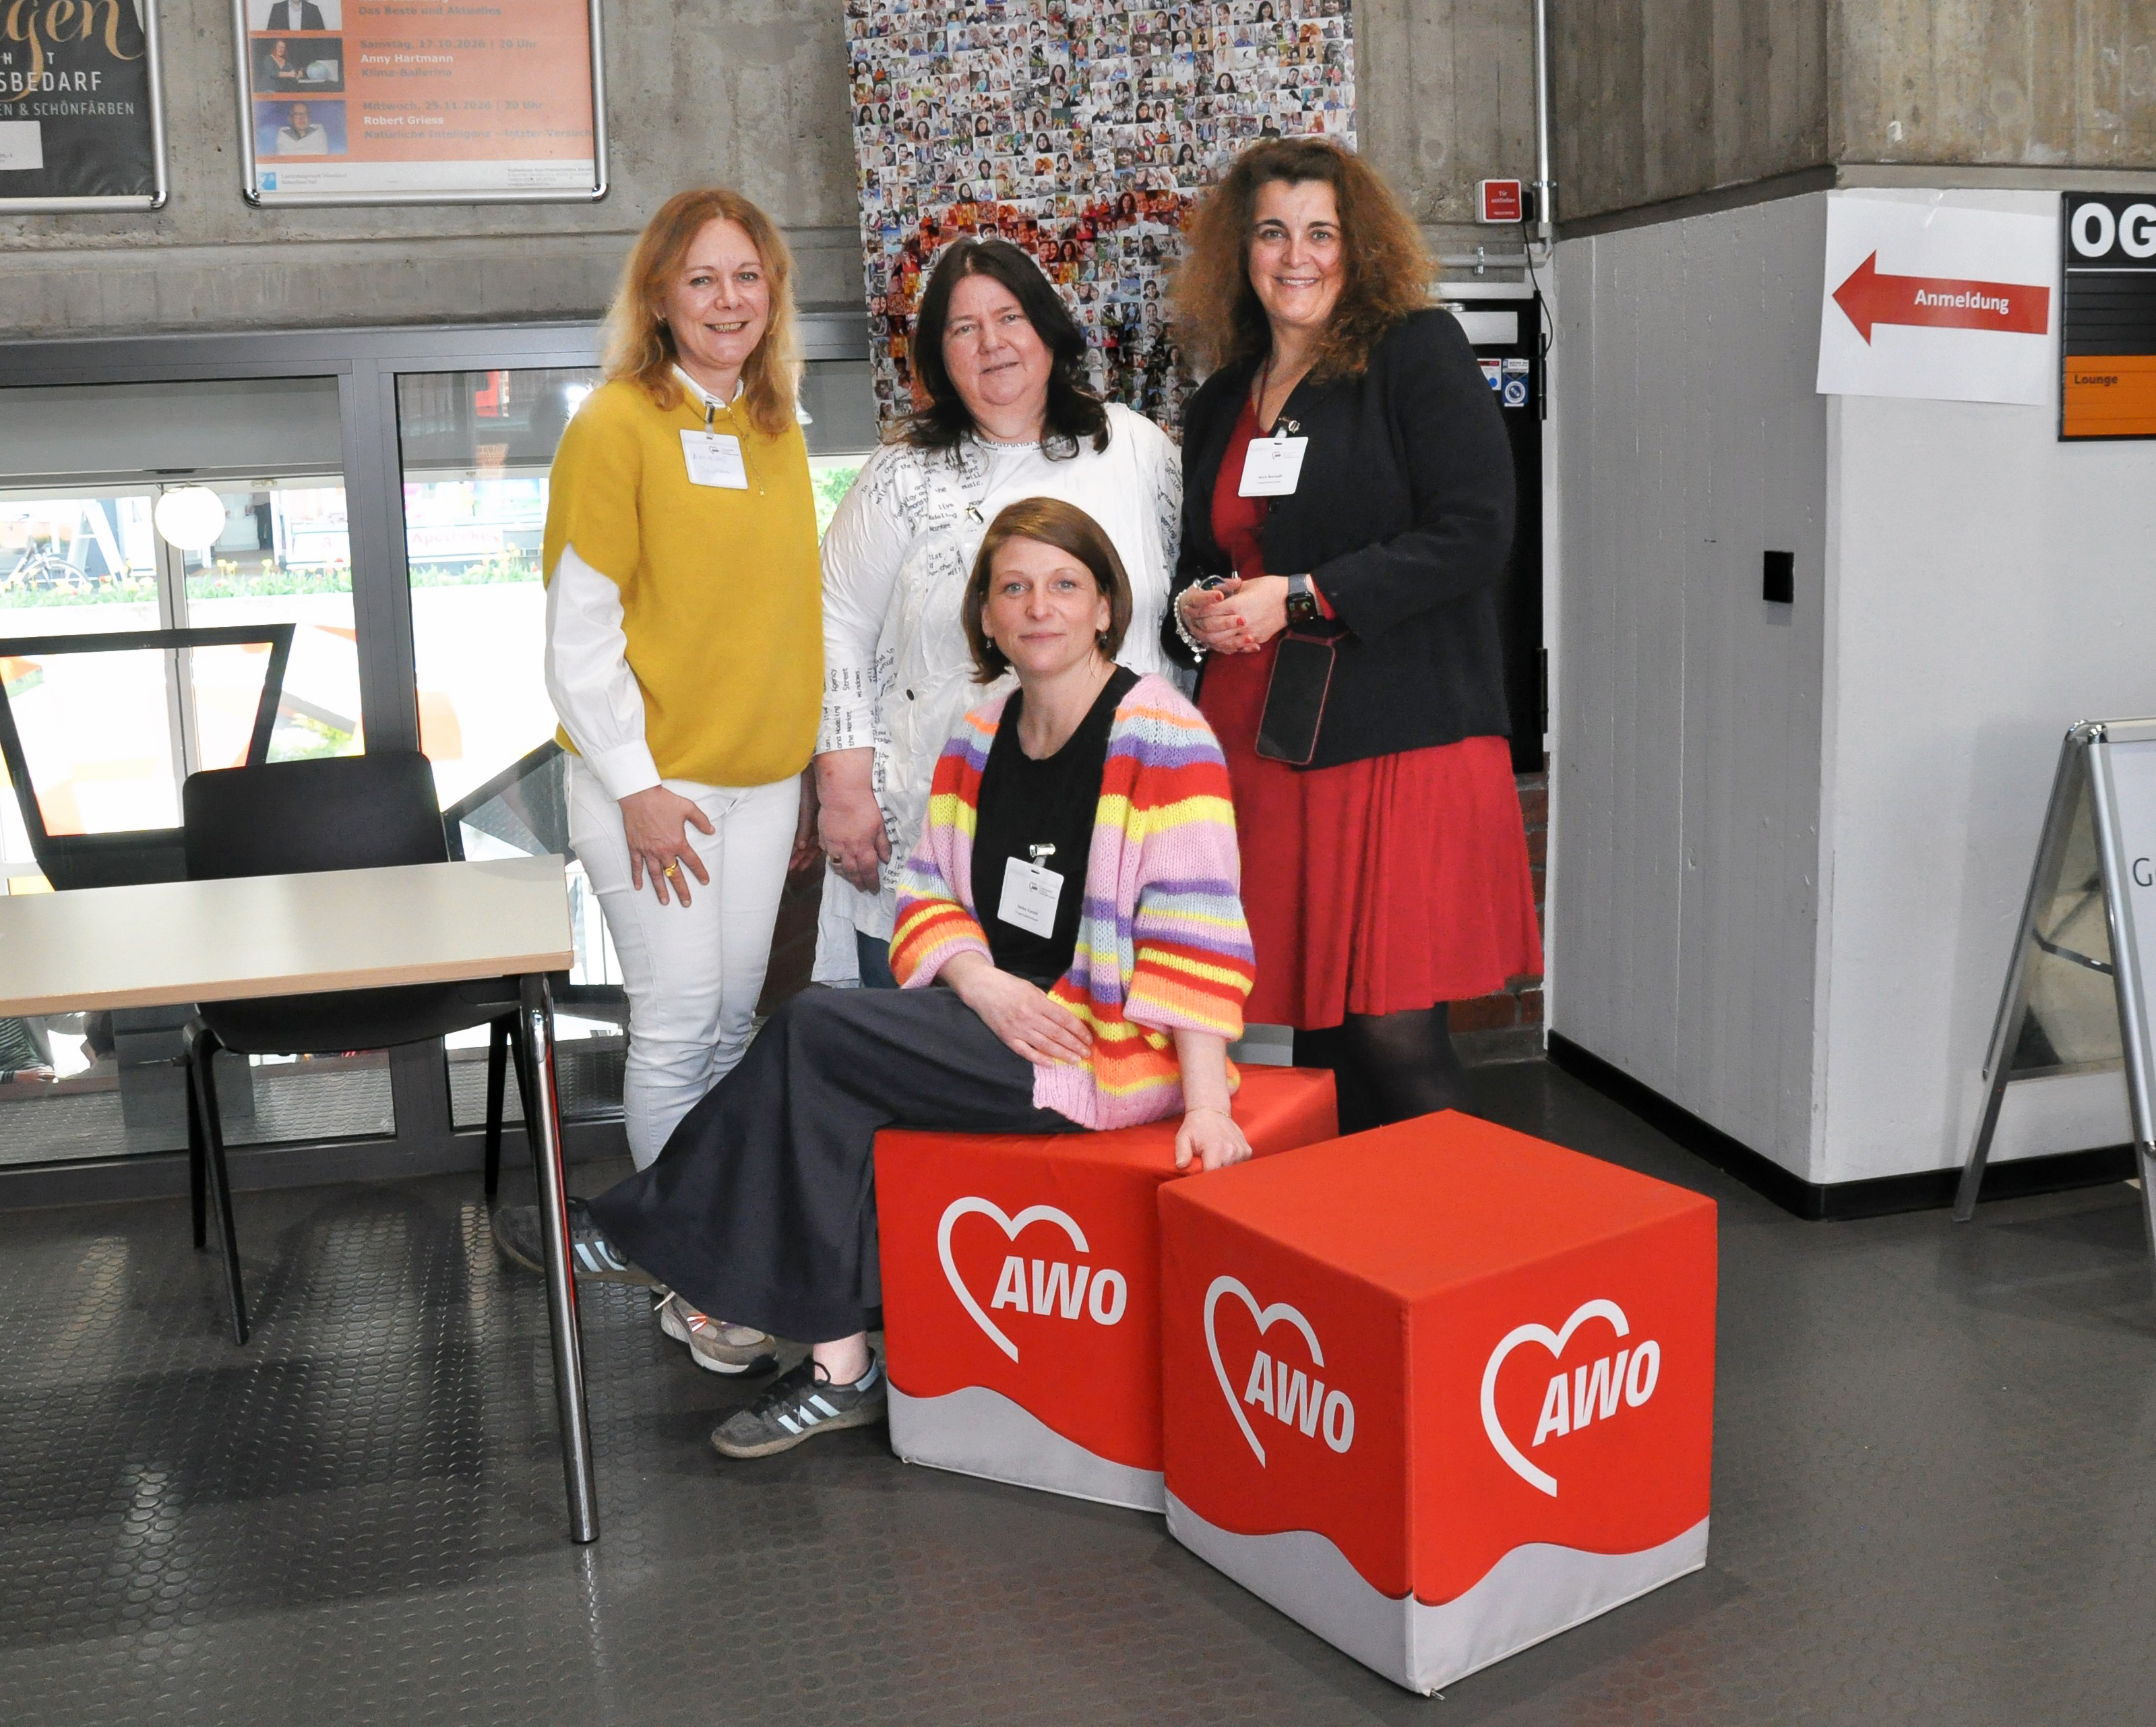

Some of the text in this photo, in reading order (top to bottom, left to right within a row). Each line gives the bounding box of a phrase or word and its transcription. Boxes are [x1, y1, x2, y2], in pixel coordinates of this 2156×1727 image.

[359, 6, 502, 16] Das Beste und Aktuelles
[360, 39, 414, 50] Samstag,
[499, 39, 513, 49] 20
[517, 39, 537, 49] Uhr
[361, 54, 454, 65] Anny Hartmann
[20, 103, 29, 116] &
[34, 100, 134, 116] SCHÖNFÄRBEN
[363, 101, 420, 111] Mittwoch,
[505, 101, 519, 110] 20
[524, 101, 544, 110] Uhr
[364, 116, 444, 125] Robert Griess
[364, 129, 425, 139] Natürliche
[429, 129, 491, 140] Intelligenz
[1914, 289, 2009, 314] Anmeldung
[2074, 374, 2118, 386] Lounge
[412, 530, 489, 547] Apotheke
[842, 667, 851, 692] Street
[2133, 857, 2156, 887] G
[991, 1256, 1128, 1326] AWO
[1532, 1339, 1661, 1446] AWO
[1243, 1350, 1355, 1454] AWO
